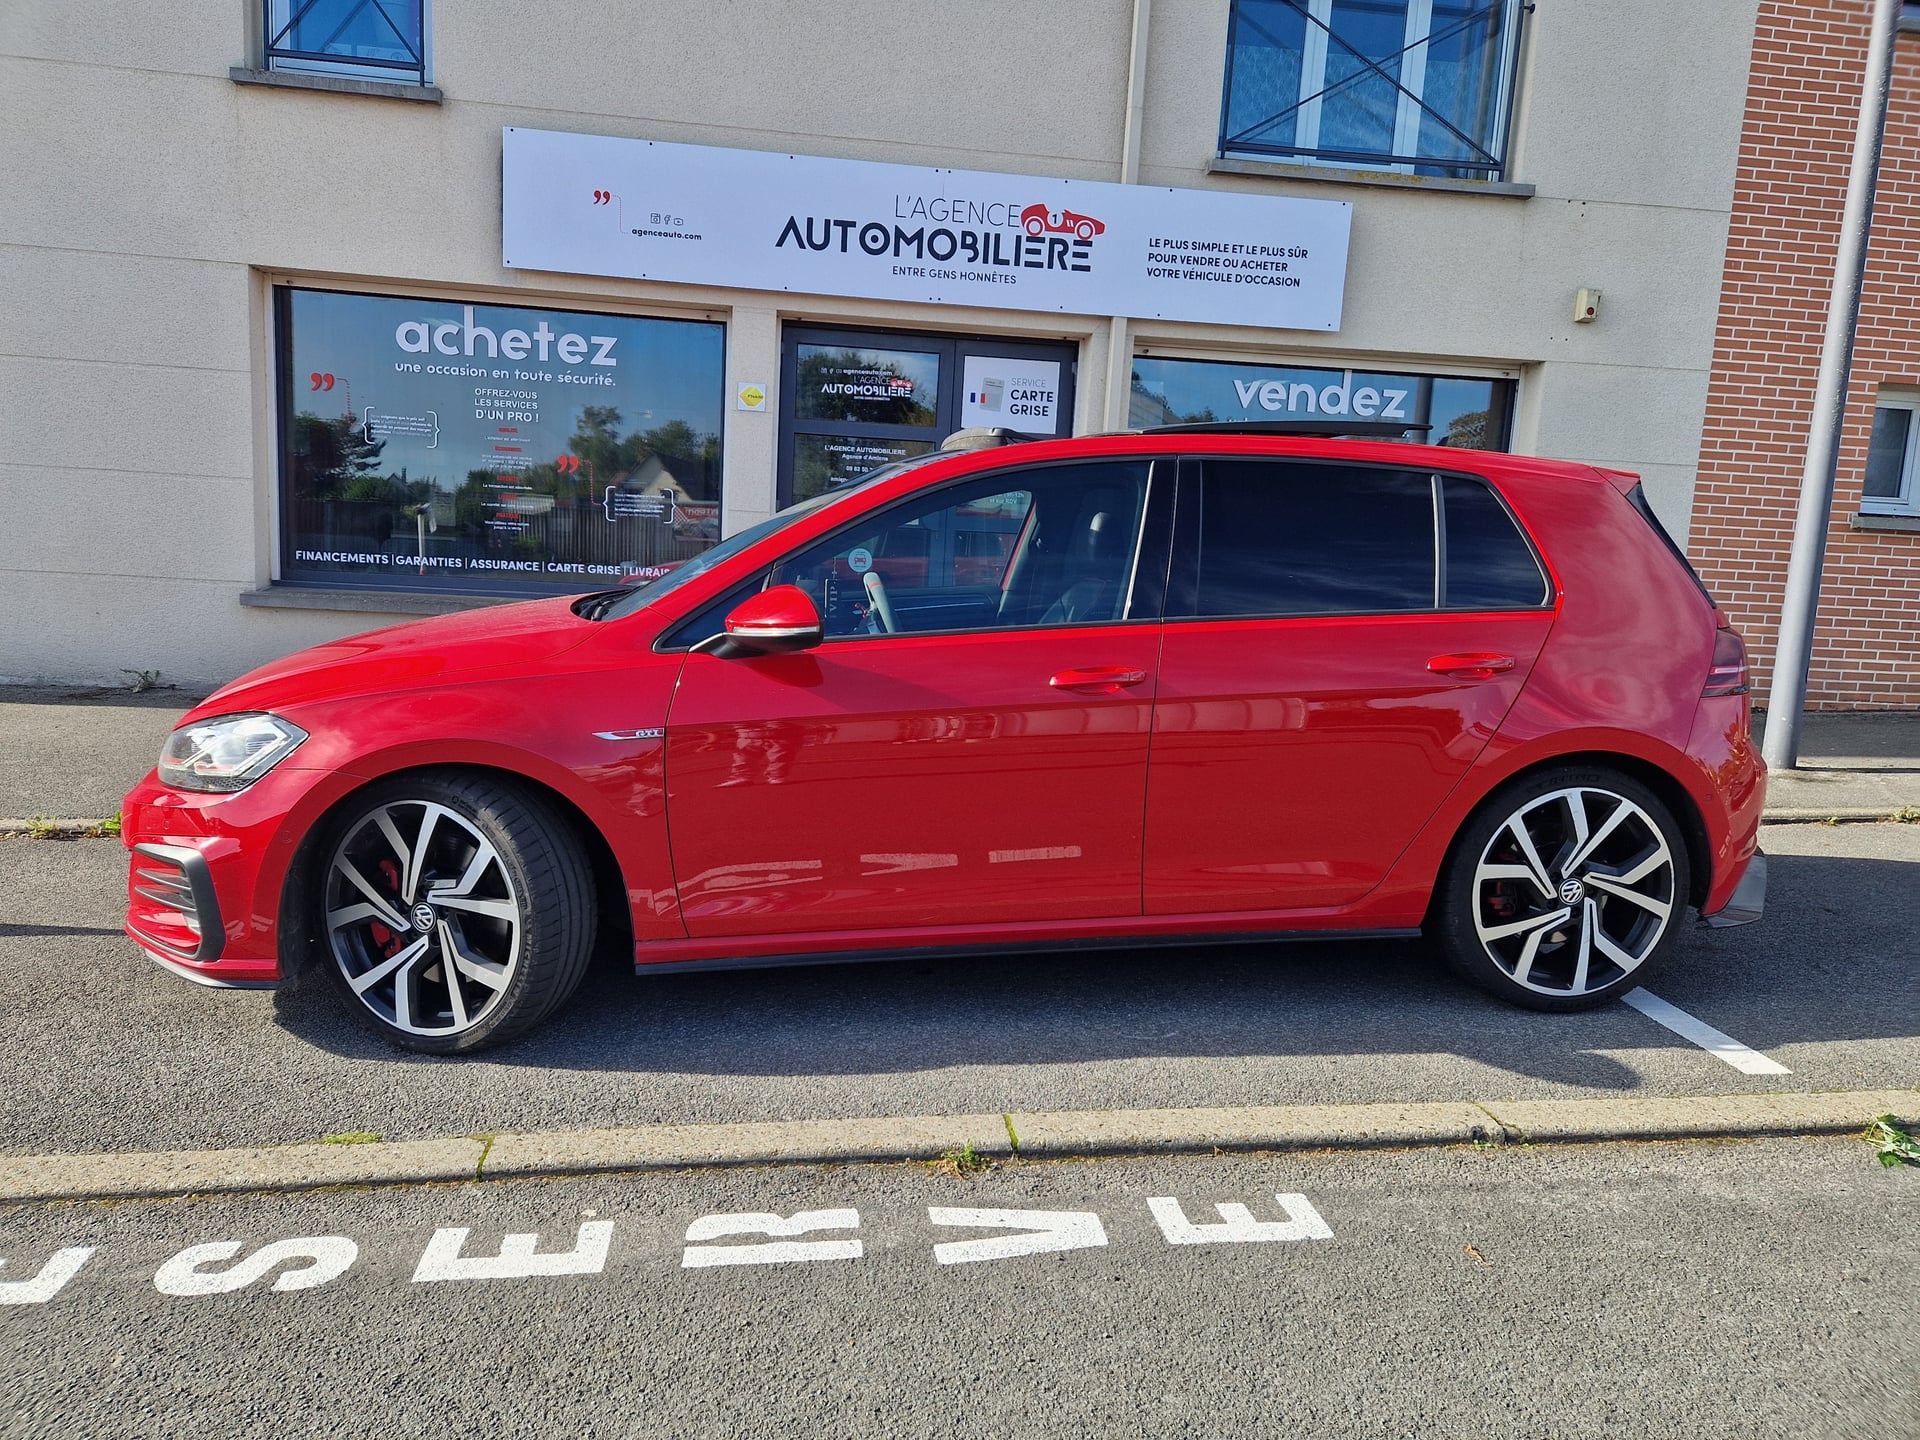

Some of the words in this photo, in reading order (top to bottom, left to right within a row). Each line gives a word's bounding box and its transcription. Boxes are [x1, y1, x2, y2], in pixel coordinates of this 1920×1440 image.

[895, 194, 1021, 228] L'AGENCE
[631, 227, 702, 241] agenceauto.com
[1149, 238, 1161, 248] LE
[1163, 239, 1189, 250] PLUS
[1191, 241, 1229, 253] SIMPLE
[1231, 244, 1244, 254] ET
[1246, 245, 1258, 255] LE
[1260, 246, 1285, 257] PLUS
[1287, 246, 1308, 259] SÛR
[1148, 252, 1177, 264] POUR
[1180, 255, 1220, 267] VENDRE
[1222, 258, 1238, 268] OU
[1240, 260, 1288, 272] ACHETER
[892, 266, 926, 278] ENTRE
[928, 268, 957, 280] GENS
[959, 270, 1017, 284] HONNÊTES
[1147, 267, 1180, 279] VOTRE
[1182, 268, 1233, 283] VÉHICULE
[1234, 273, 1301, 287] D'OCCASION
[395, 305, 618, 367] achetez
[394, 362, 421, 373] une
[426, 363, 488, 378] occasion
[492, 369, 509, 379] en
[515, 368, 552, 382] toute
[557, 370, 616, 387] sécurité.
[1011, 377, 1046, 388] SERVICE
[474, 388, 538, 400] OFFREZ-VOUS
[1010, 389, 1054, 402] CARTE
[1233, 369, 1408, 418] vendez
[474, 398, 491, 408] LES
[494, 399, 538, 410] SERVICES
[1010, 403, 1049, 417] GRISE
[475, 409, 505, 420] D'UN
[507, 411, 532, 422] PRO
[824, 444, 855, 453] L'AGENCE
[295, 550, 389, 564] FINANCEMENTS
[395, 555, 462, 568] GARANTIES
[470, 558, 539, 572] ASSURANCE
[547, 562, 585, 574] CARTE
[587, 564, 621, 575] GRISE
